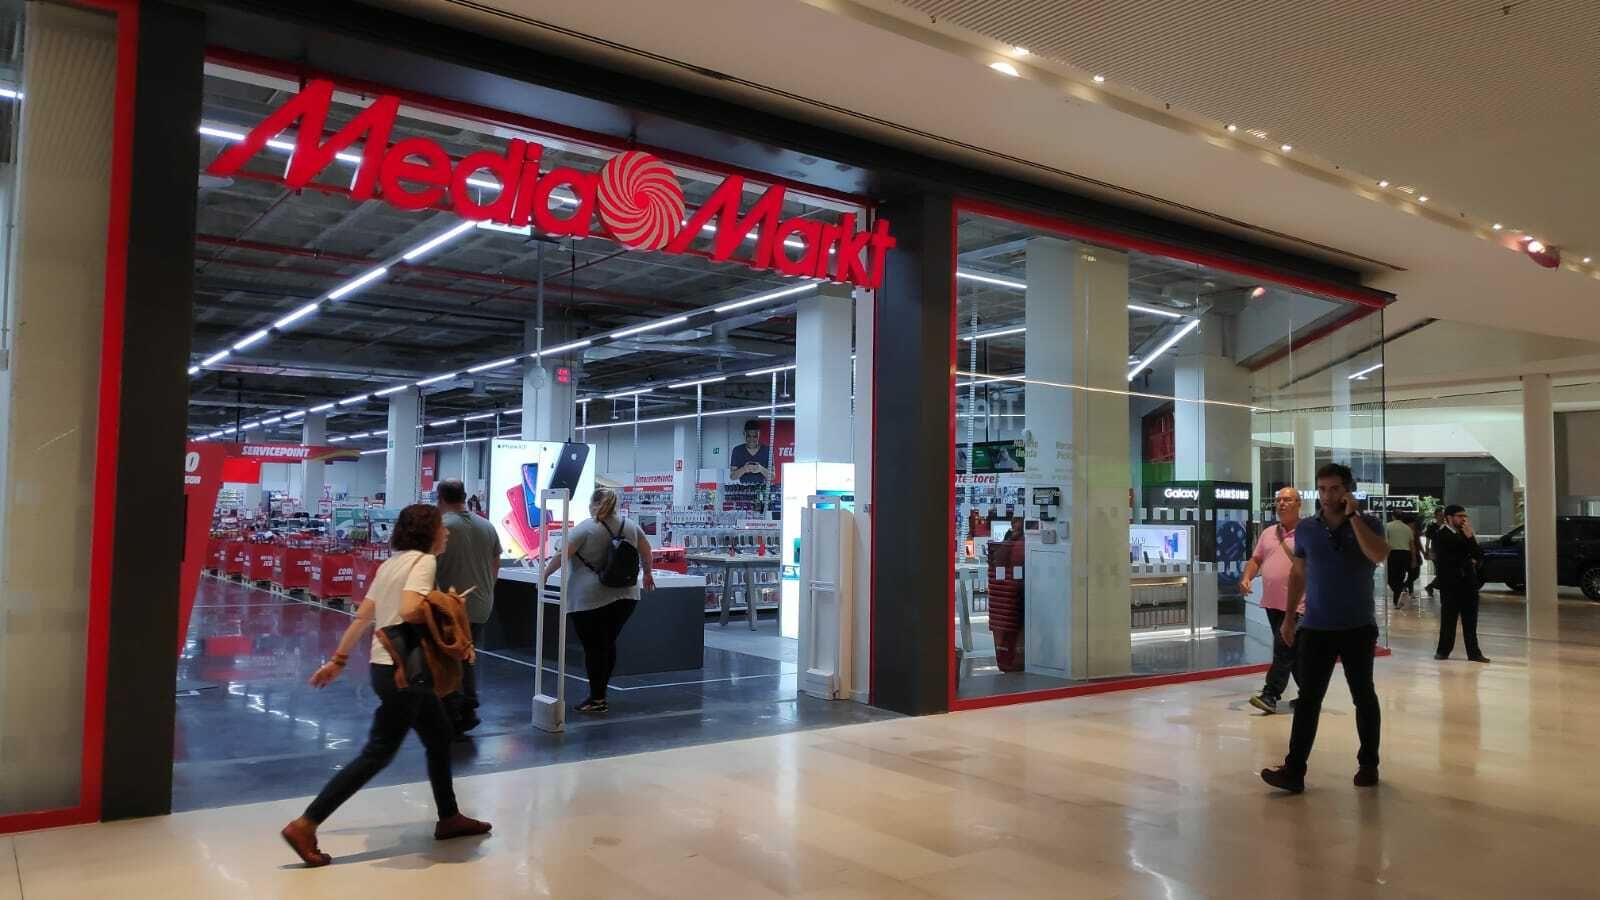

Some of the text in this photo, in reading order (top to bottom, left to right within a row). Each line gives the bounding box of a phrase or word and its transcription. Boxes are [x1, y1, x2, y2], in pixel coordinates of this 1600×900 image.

[207, 78, 896, 289] Media Markt
[241, 445, 311, 458] SERVICEPOINT
[1164, 488, 1199, 501] Galaxy
[1215, 488, 1250, 500] SAMSUNG
